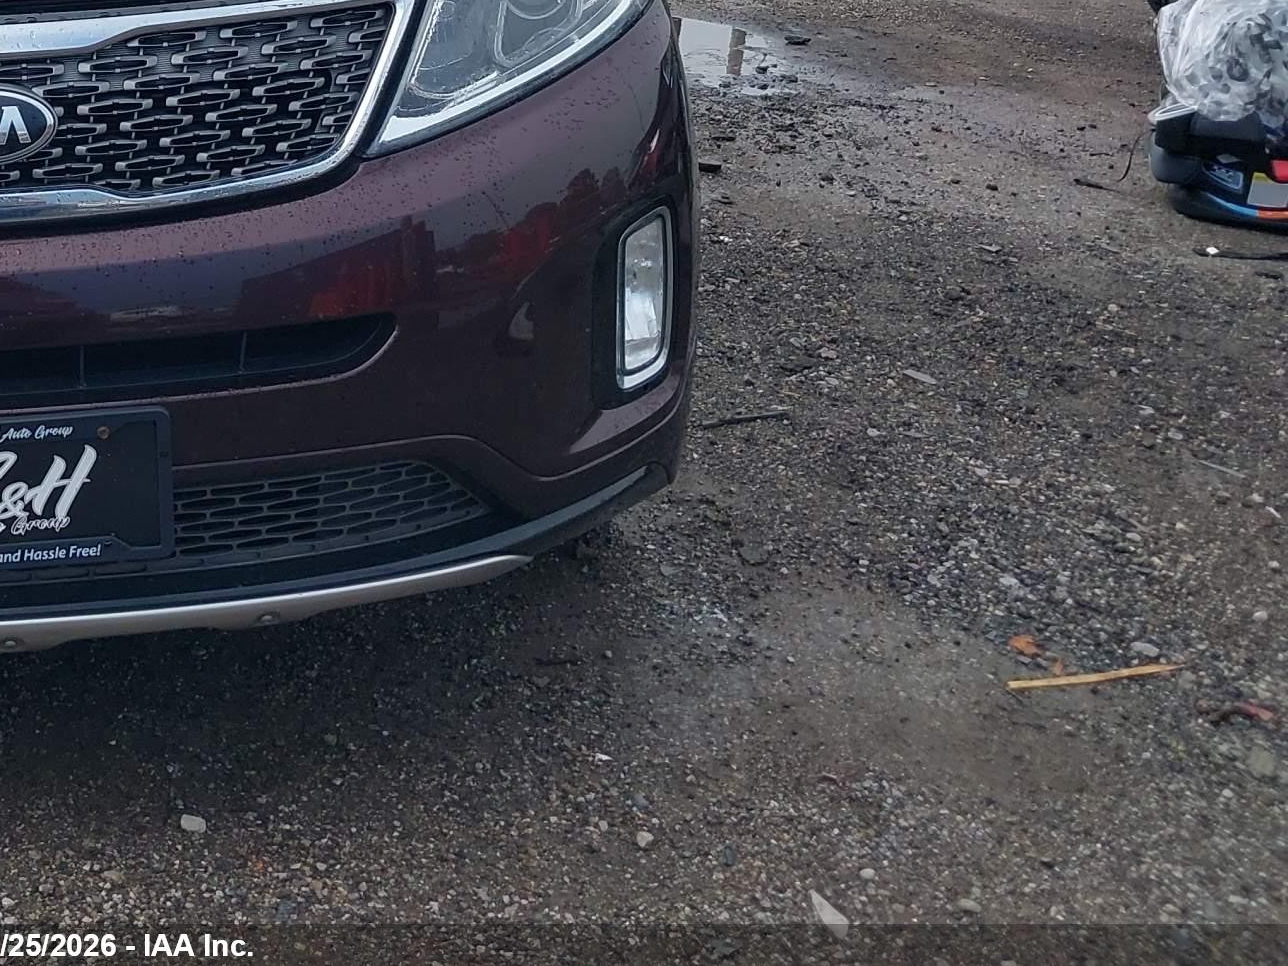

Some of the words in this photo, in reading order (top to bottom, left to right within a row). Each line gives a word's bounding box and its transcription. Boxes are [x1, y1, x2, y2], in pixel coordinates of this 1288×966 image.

[35, 424, 73, 439] Group
[11, 514, 70, 535] Group
[24, 546, 66, 561] Hassle
[69, 544, 101, 557] Free!
